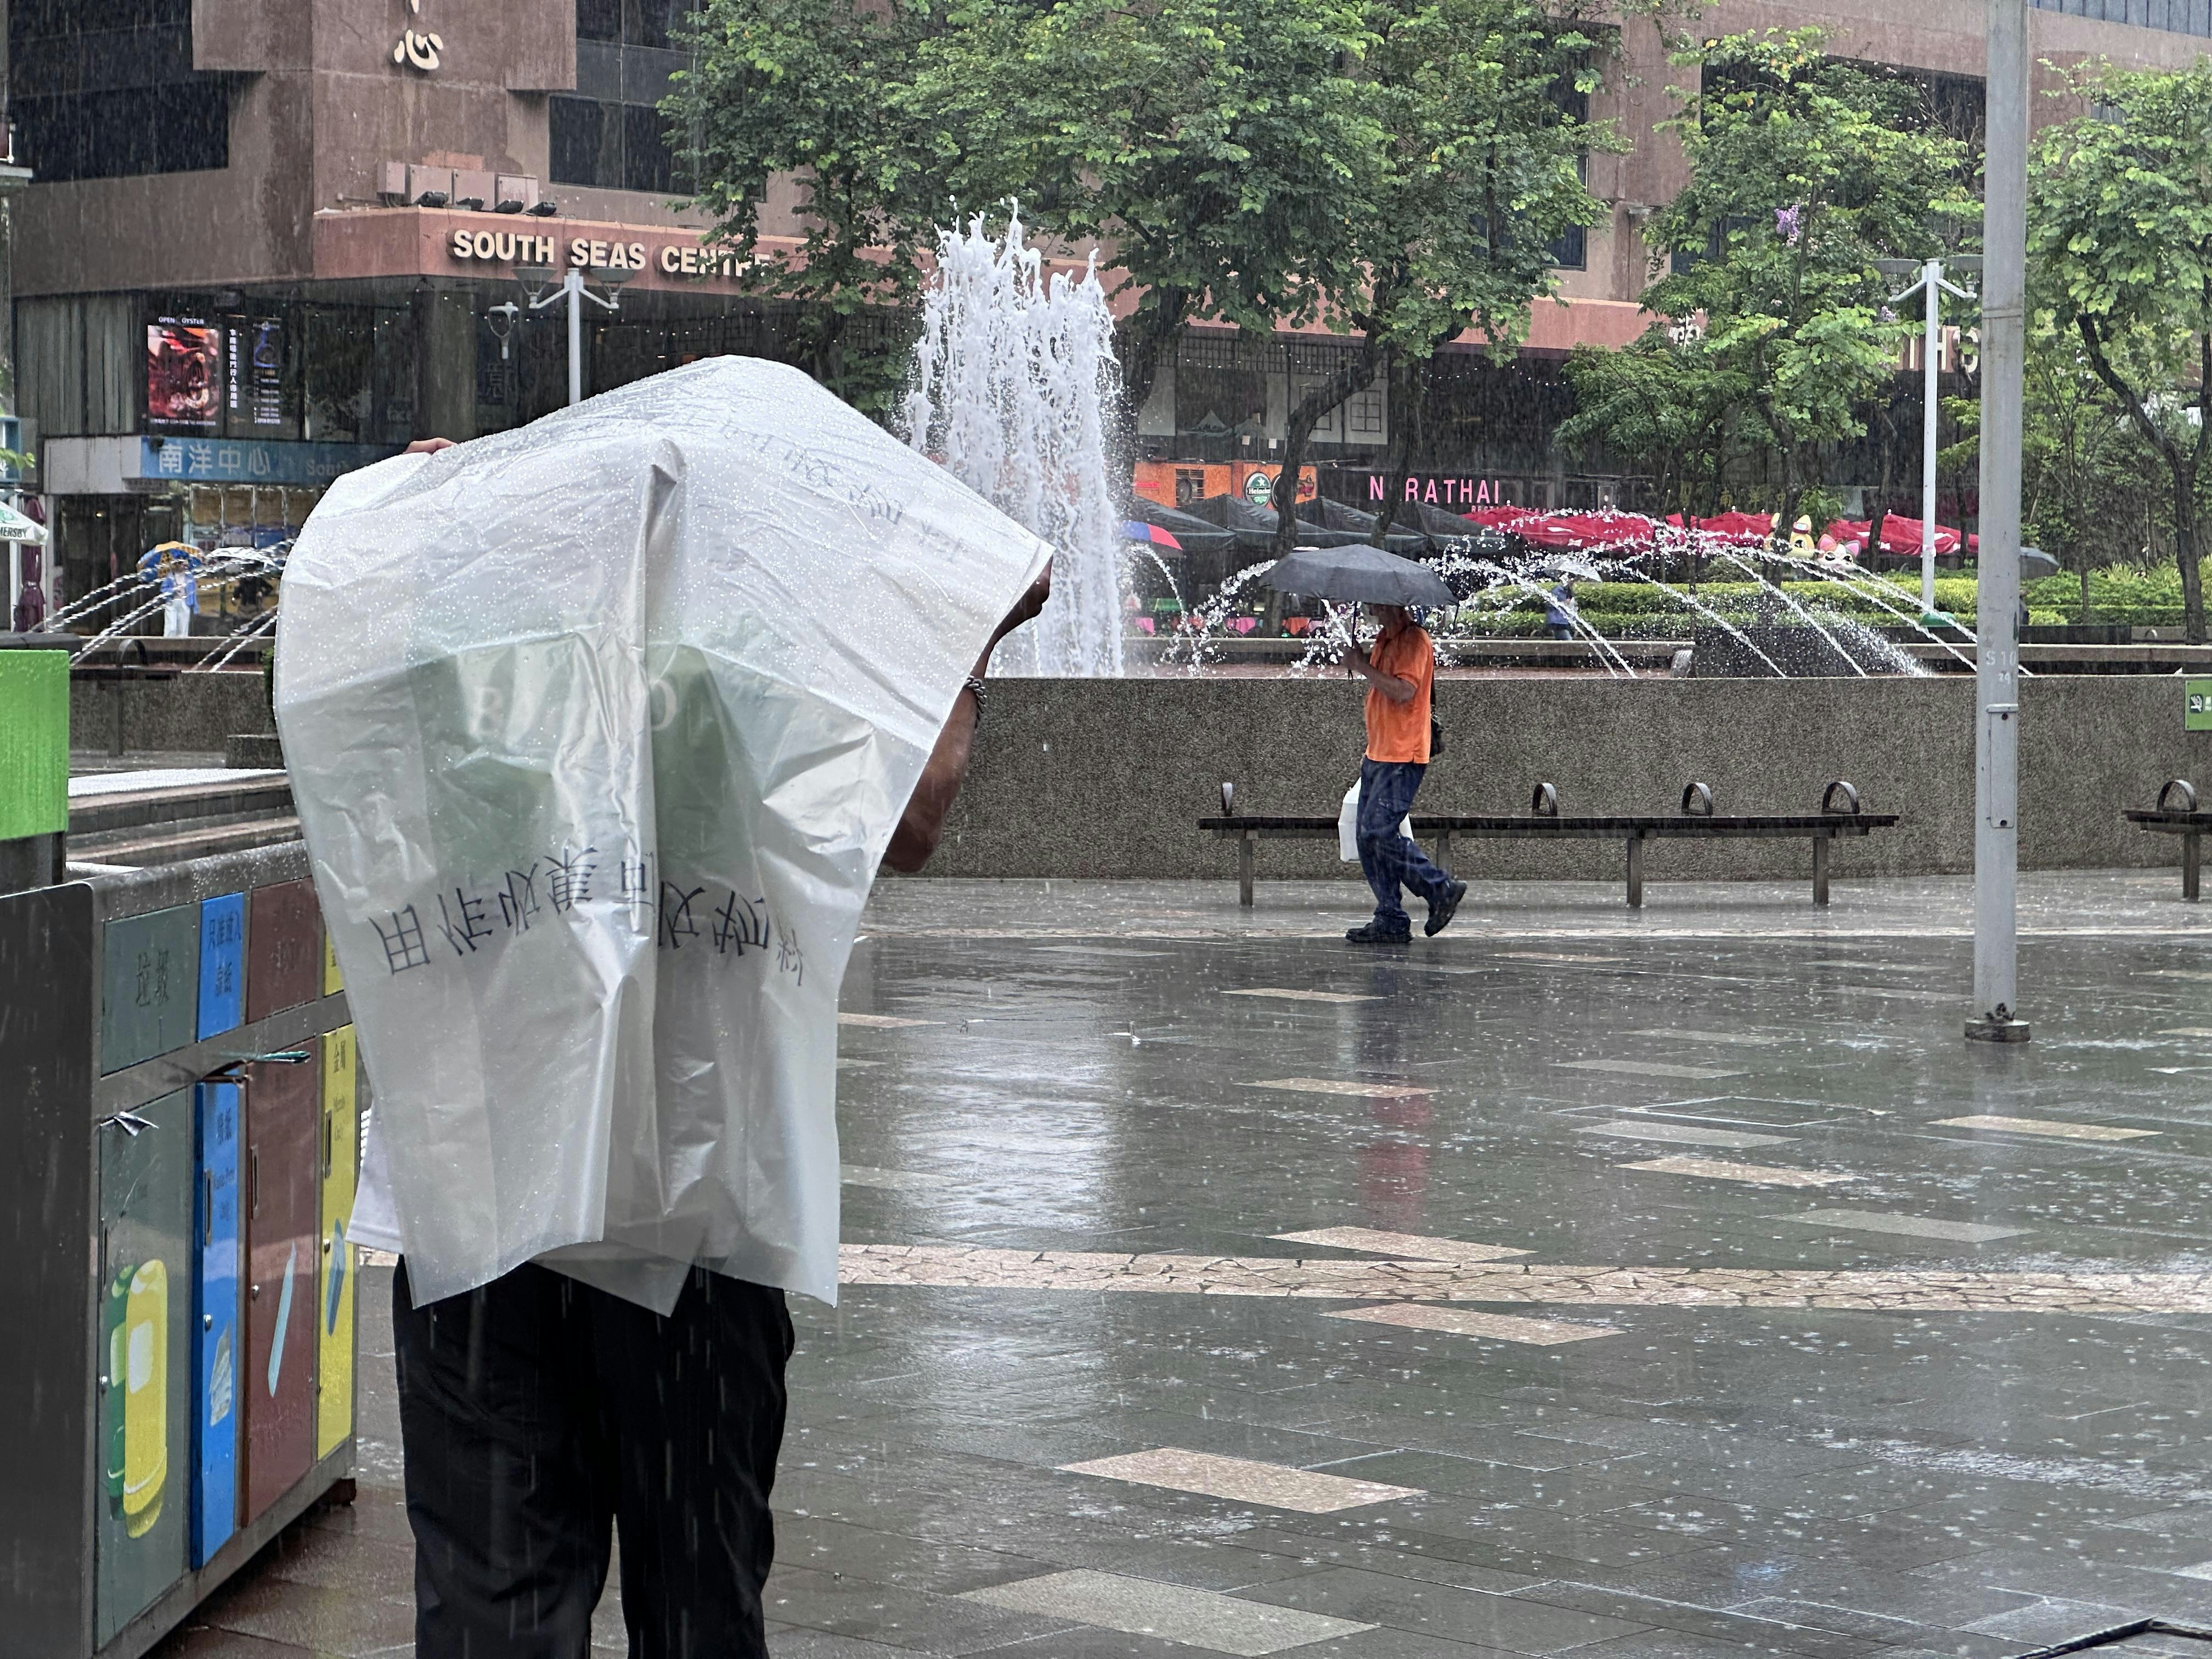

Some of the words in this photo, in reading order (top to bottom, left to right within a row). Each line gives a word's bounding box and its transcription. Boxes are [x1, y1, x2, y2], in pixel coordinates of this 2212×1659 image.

[454, 229, 554, 263] SOUTH
[571, 238, 646, 270] SEAS
[158, 443, 270, 476] 南洋中心
[1369, 475, 1499, 504] NRATHAI
[136, 950, 170, 1007] 垃圾
